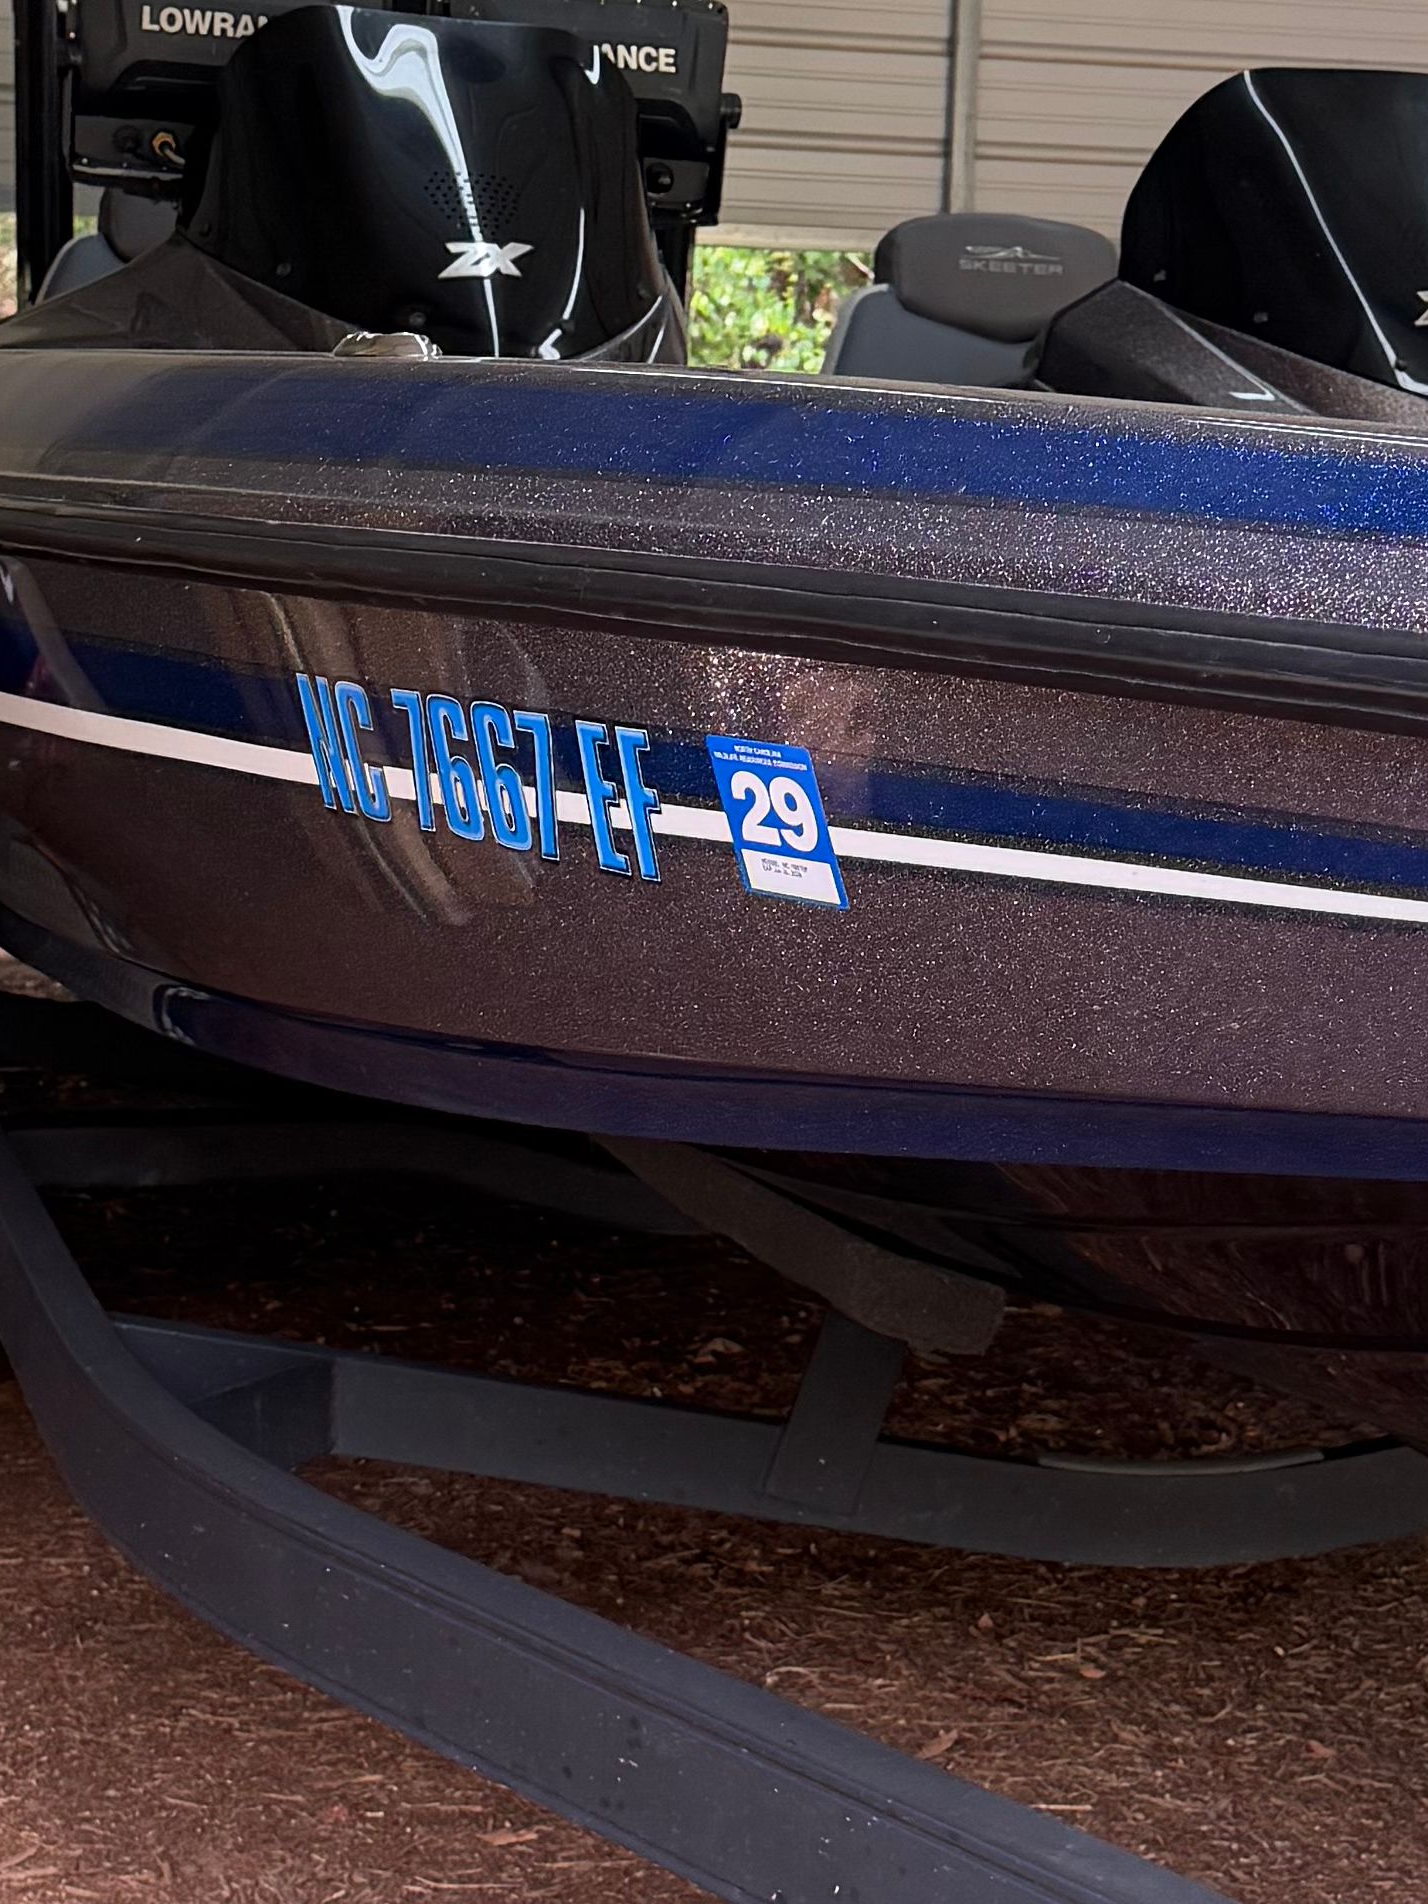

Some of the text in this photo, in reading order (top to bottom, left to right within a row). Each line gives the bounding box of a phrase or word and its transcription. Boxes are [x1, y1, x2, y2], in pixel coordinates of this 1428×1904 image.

[958, 258, 1064, 275] SKEETER
[295, 672, 662, 882] NC 7667 EF
[730, 770, 819, 853] 29
